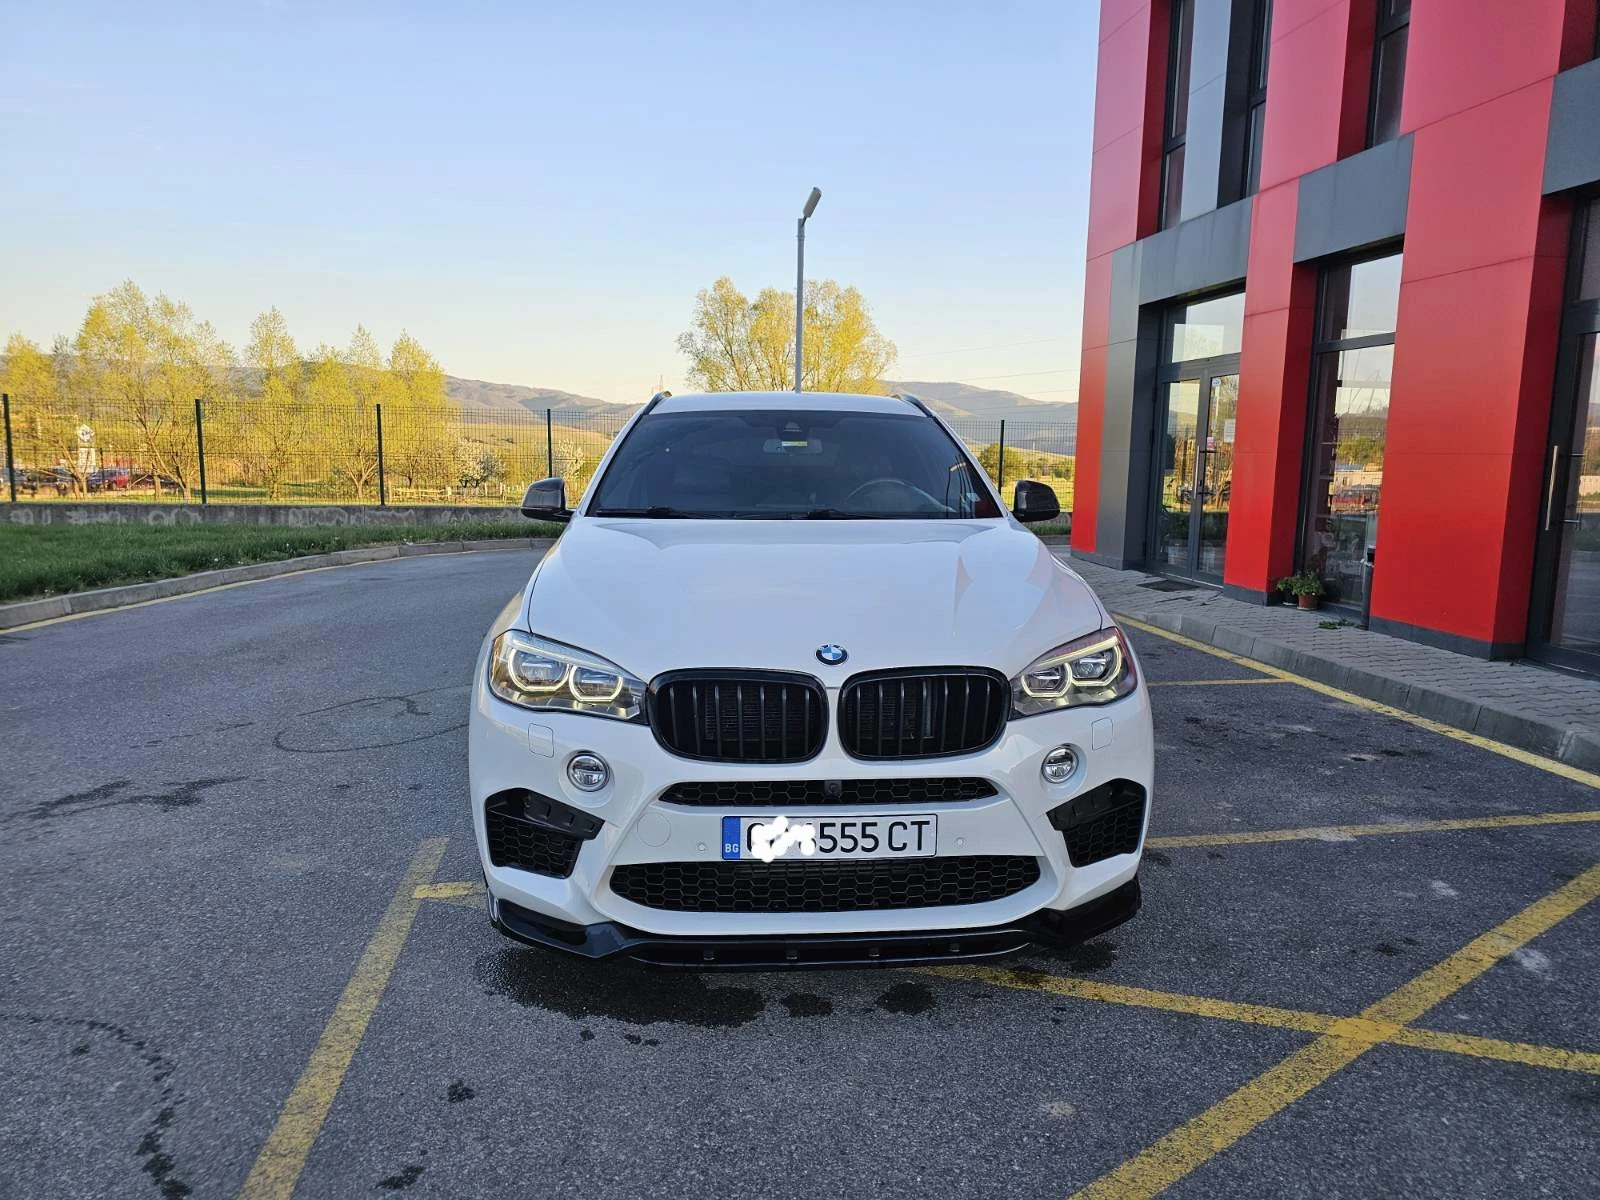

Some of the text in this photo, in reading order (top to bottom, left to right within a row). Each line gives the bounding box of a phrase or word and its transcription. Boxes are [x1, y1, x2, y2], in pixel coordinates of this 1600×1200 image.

[798, 822, 880, 853] 555
[887, 820, 931, 852] CT
[725, 843, 739, 853] BG
